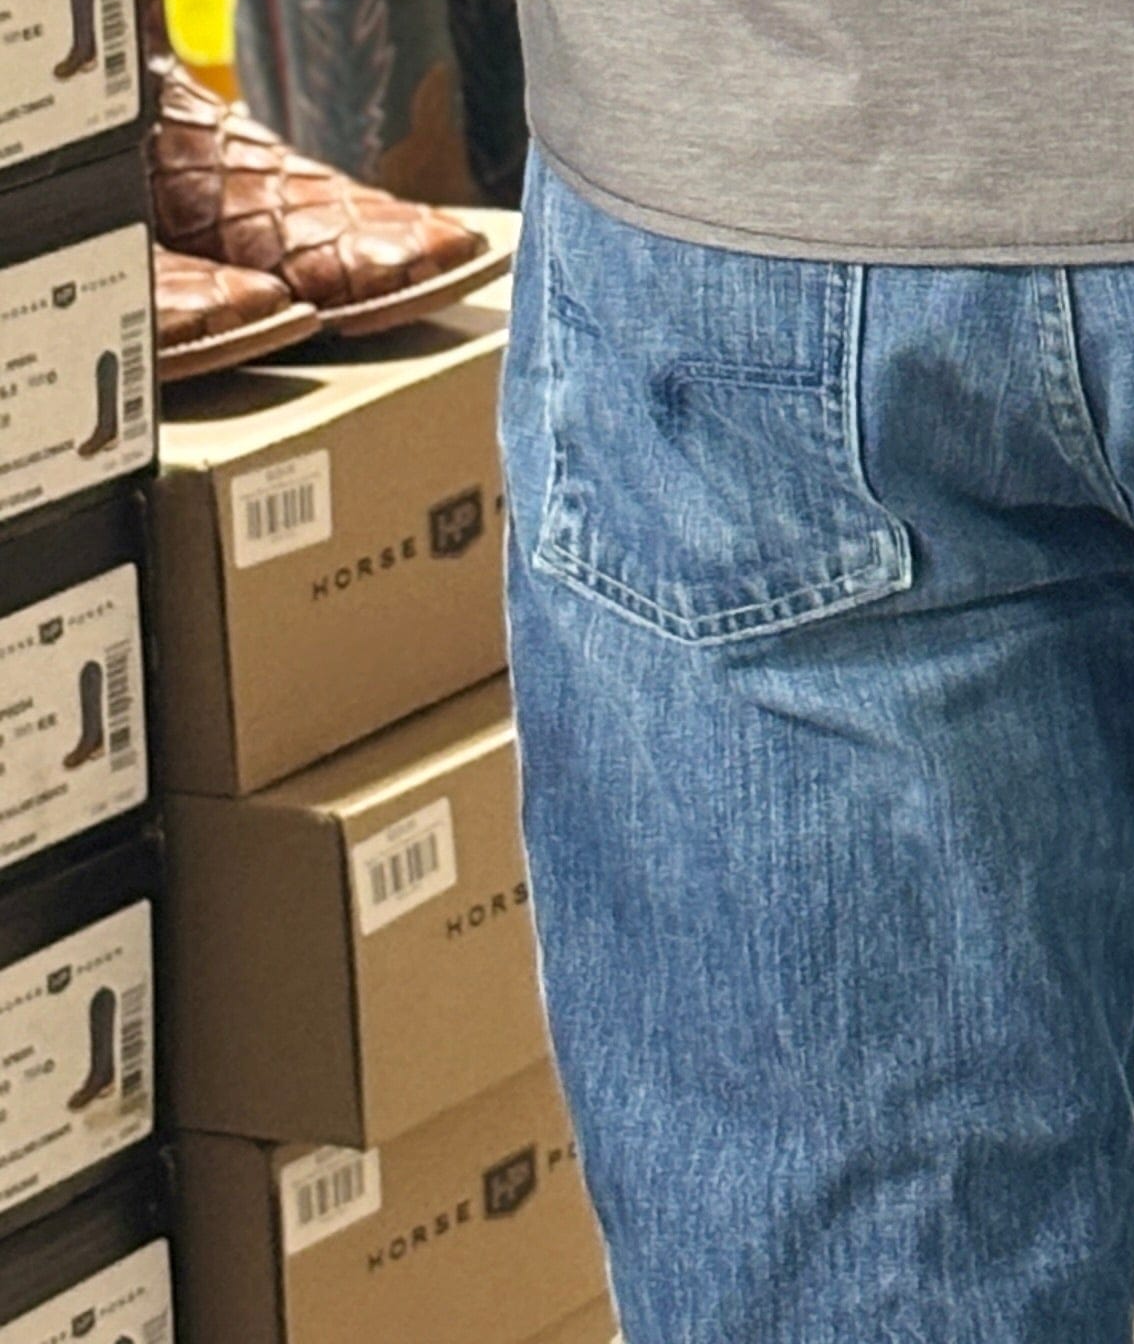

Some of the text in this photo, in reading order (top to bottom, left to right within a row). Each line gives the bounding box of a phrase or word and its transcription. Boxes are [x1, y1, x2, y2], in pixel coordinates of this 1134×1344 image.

[310, 536, 417, 601] HORSE
[446, 882, 529, 939] HORS
[366, 1200, 470, 1272] HORSE
